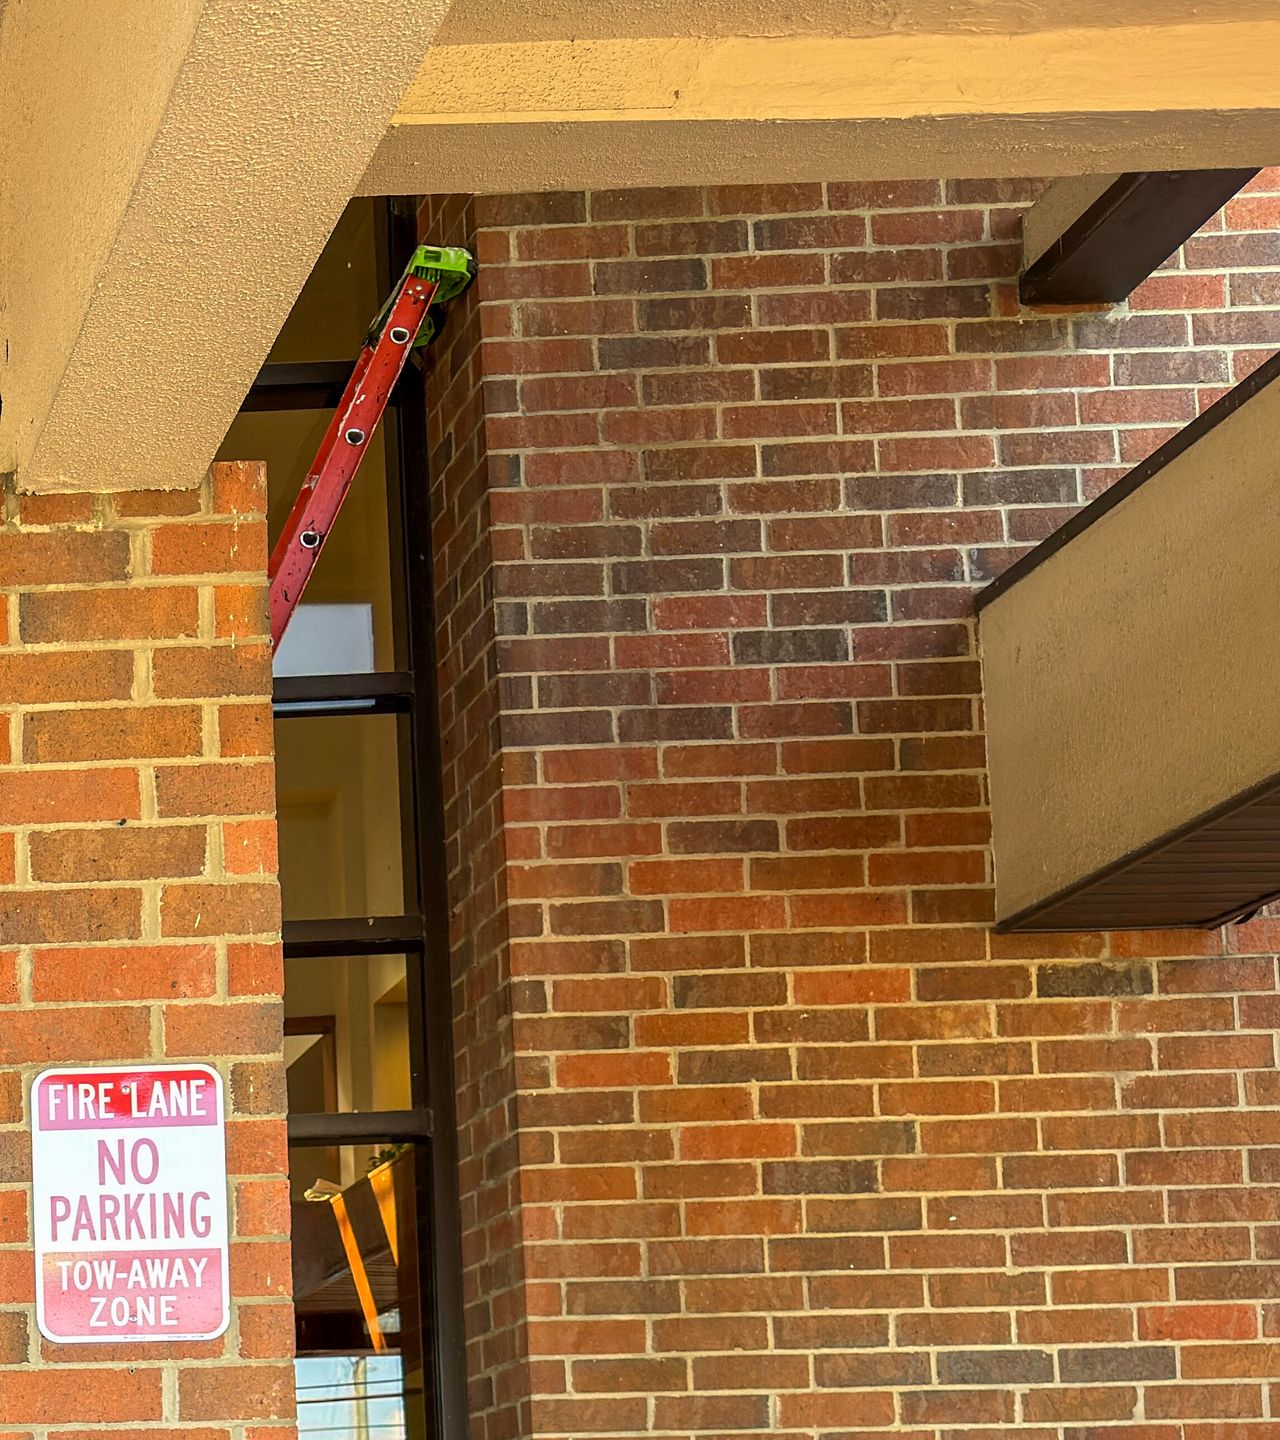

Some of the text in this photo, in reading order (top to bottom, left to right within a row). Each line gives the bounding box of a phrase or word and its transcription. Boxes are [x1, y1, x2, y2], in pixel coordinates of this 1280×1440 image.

[48, 1079, 207, 1121] FIRE LANE
[97, 1138, 159, 1185] NO
[50, 1191, 211, 1242] PARKING
[56, 1257, 208, 1291] TOW-AWAY
[90, 1295, 178, 1327] ZONE
